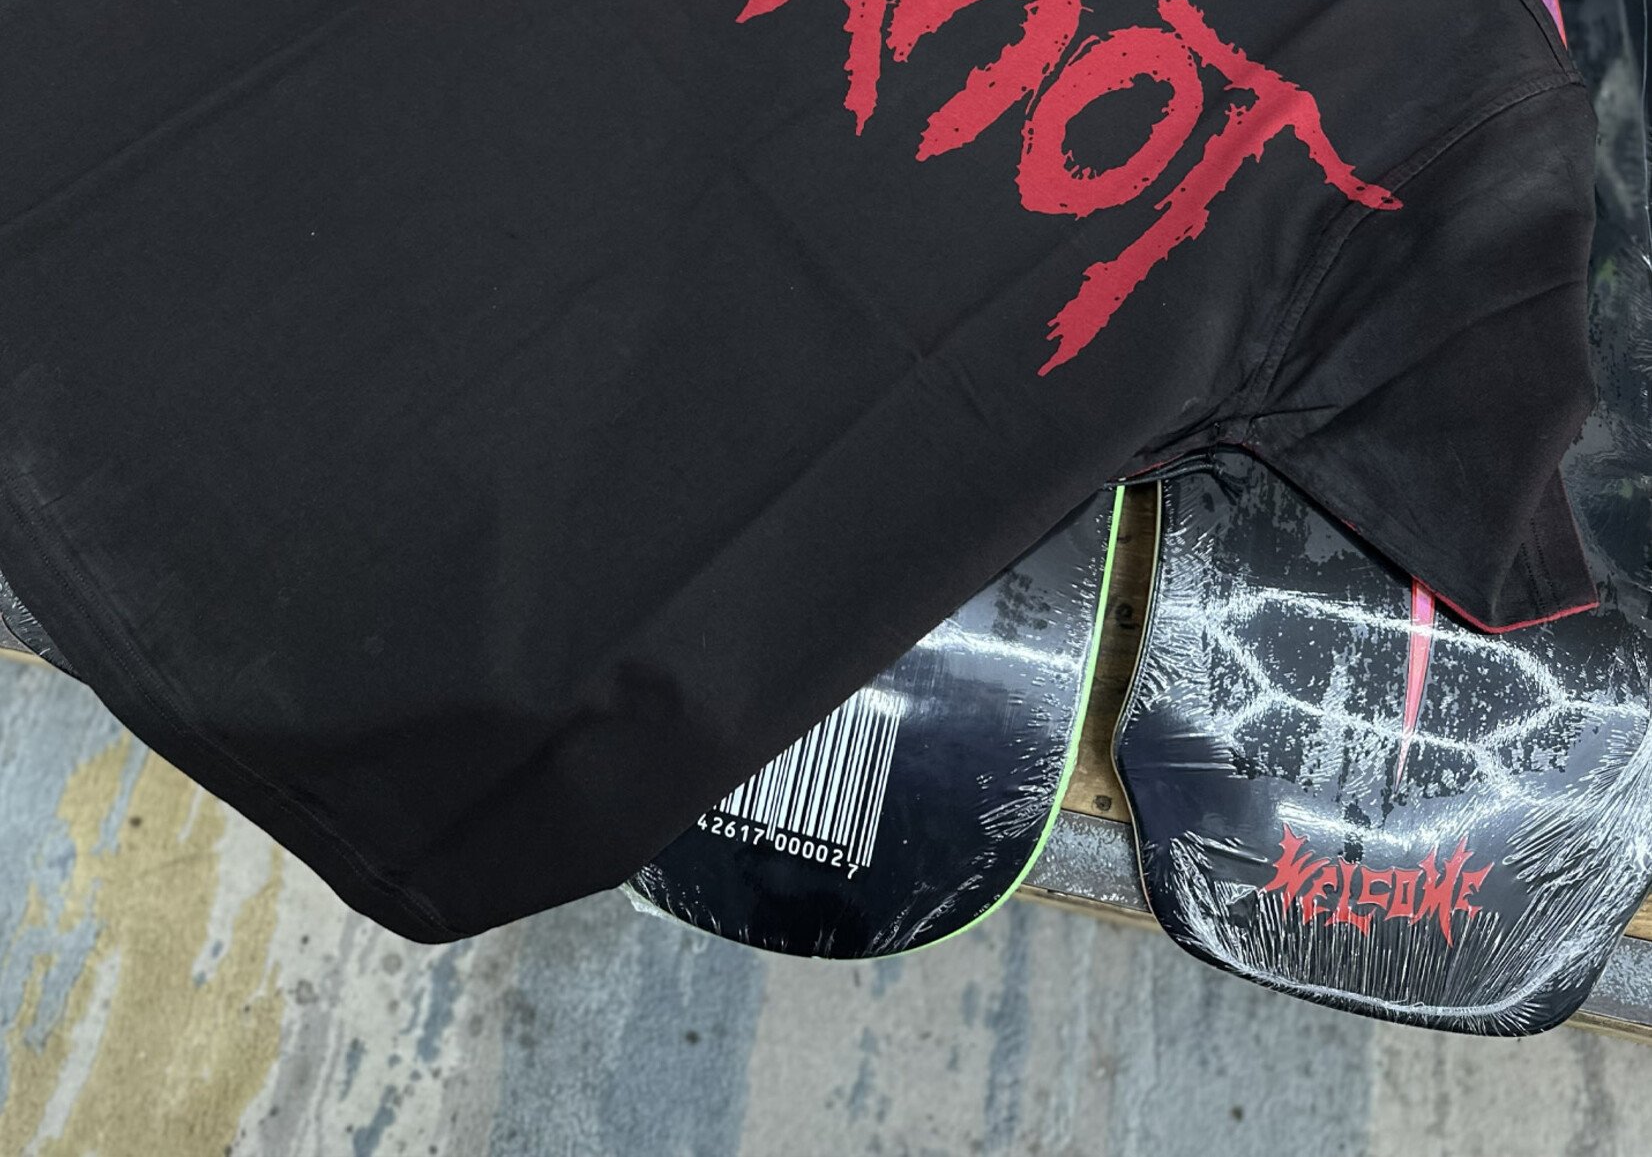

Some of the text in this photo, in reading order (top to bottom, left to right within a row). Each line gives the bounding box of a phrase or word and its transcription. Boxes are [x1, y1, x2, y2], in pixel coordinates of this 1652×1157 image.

[697, 812, 859, 880] 42617 00002 7
